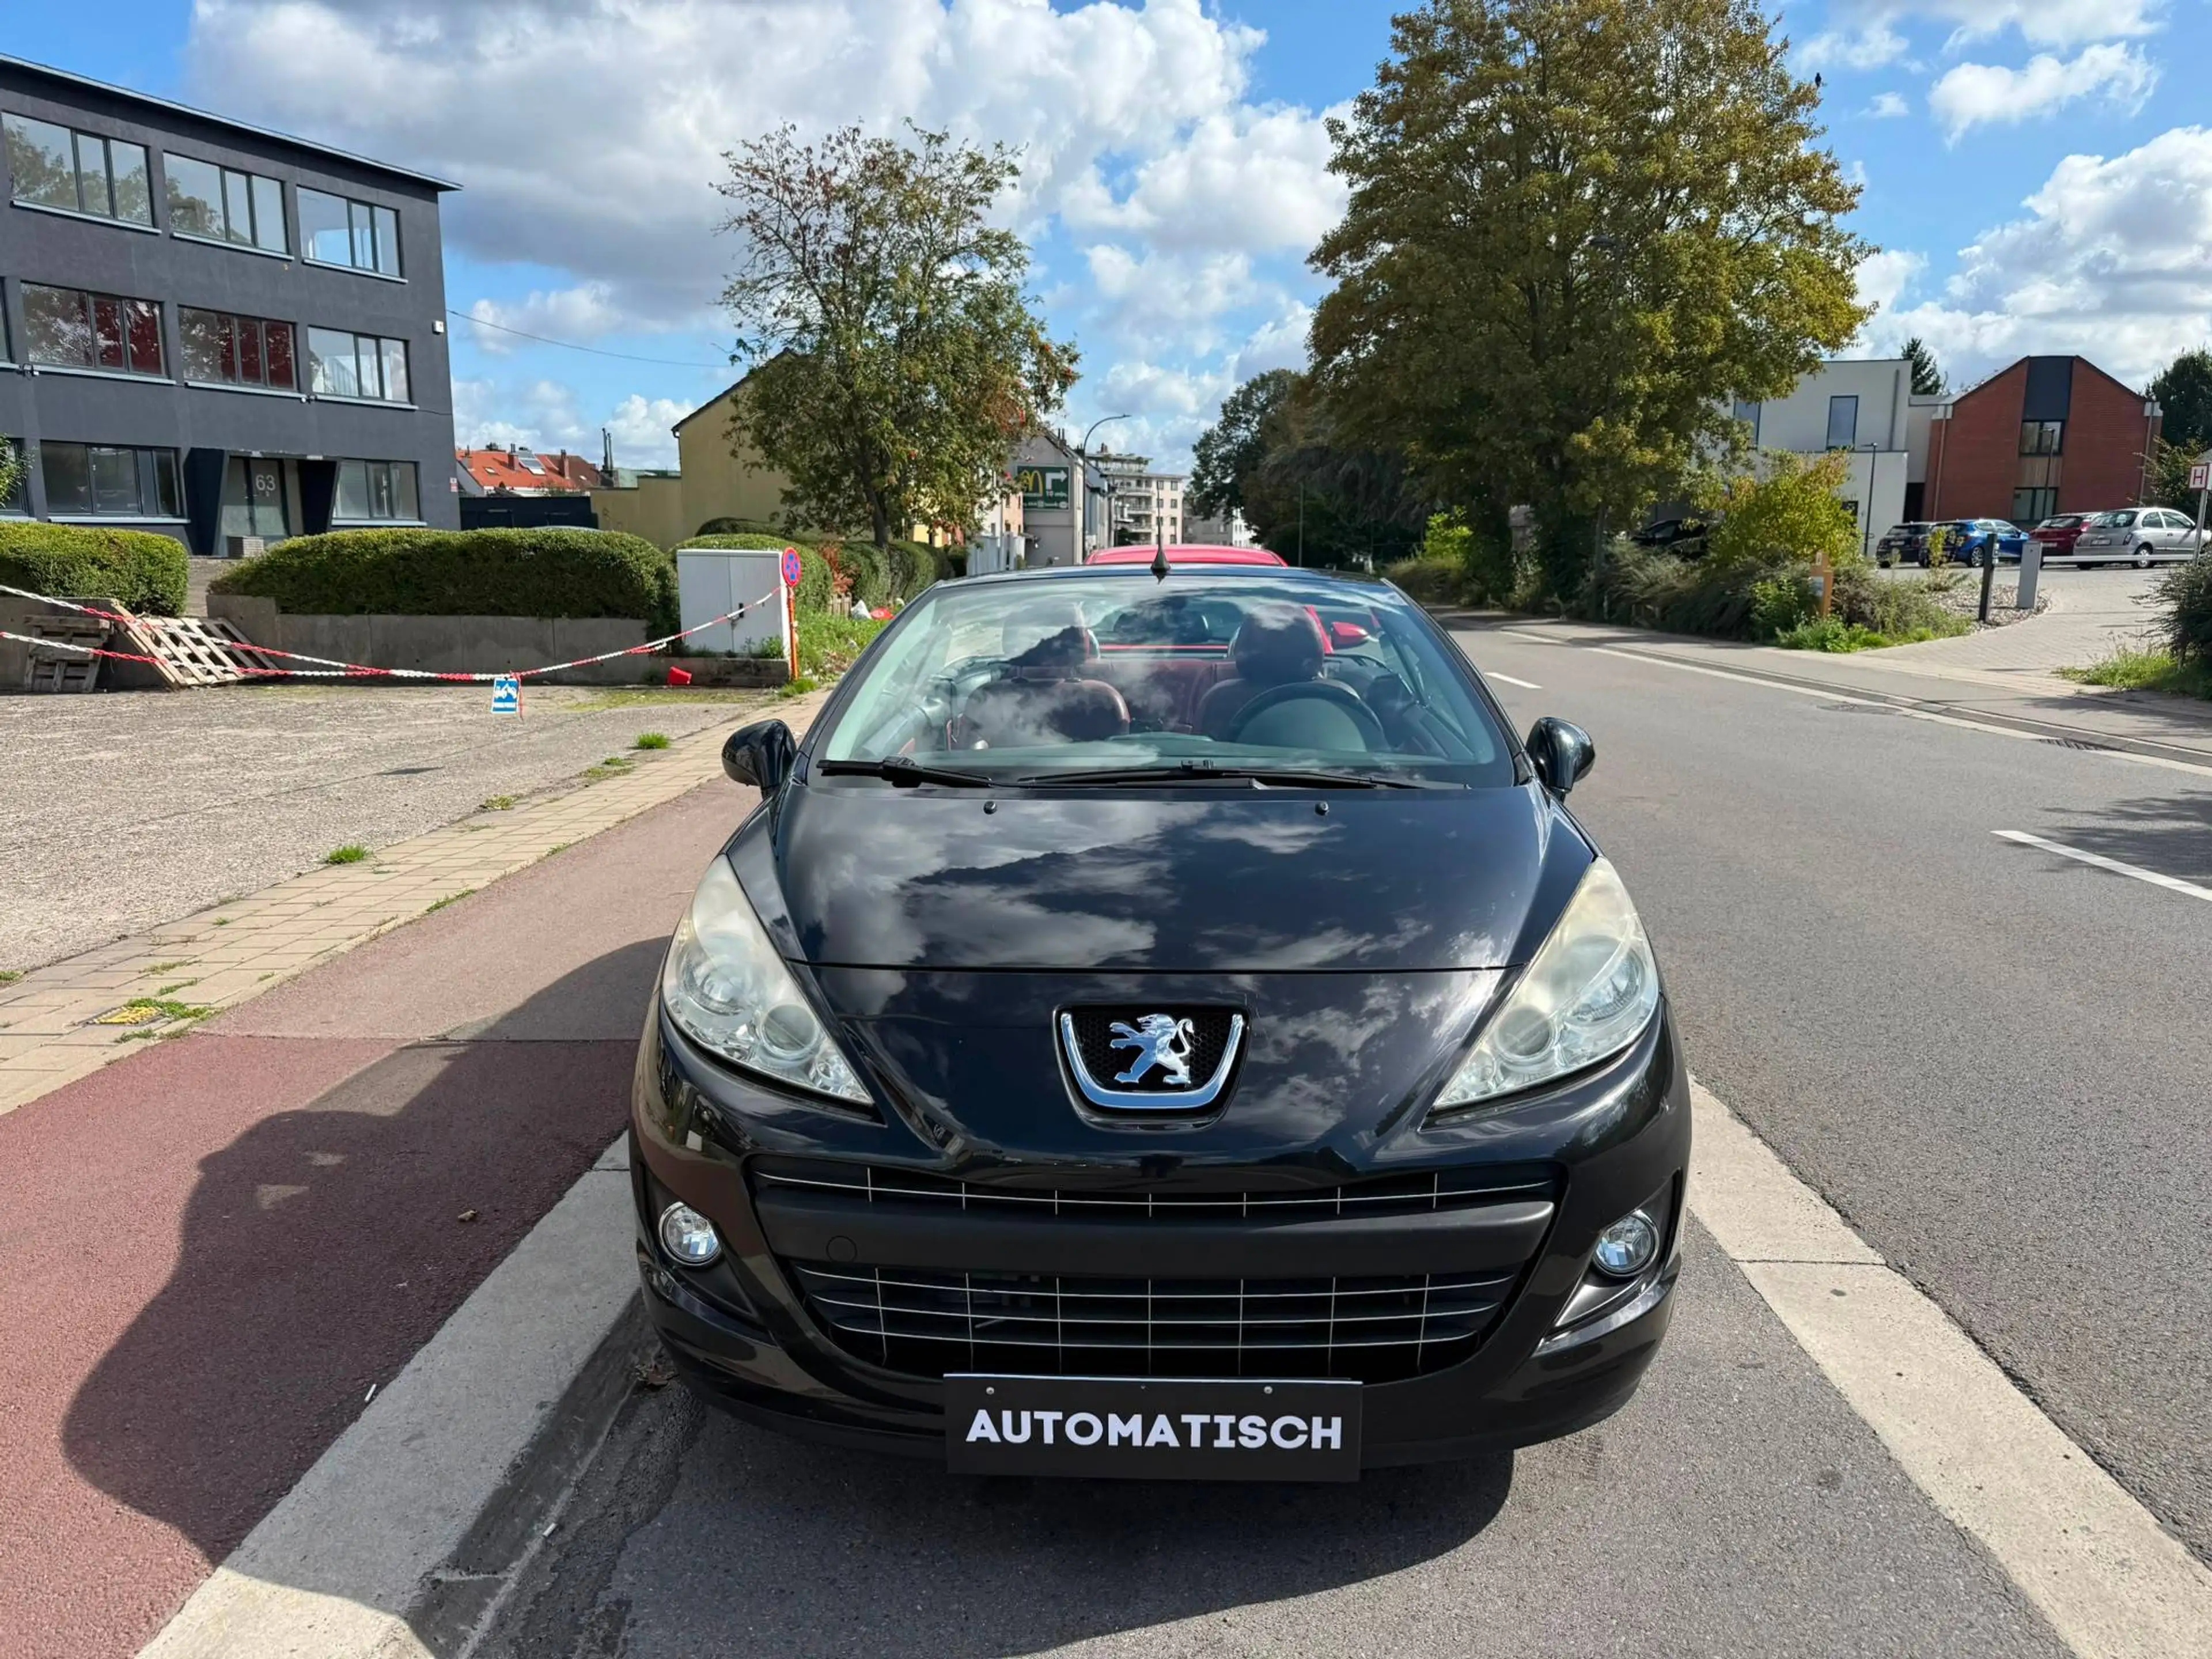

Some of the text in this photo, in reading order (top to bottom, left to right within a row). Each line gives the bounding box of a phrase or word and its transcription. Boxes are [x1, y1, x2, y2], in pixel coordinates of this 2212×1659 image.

[256, 475, 276, 491] 63
[2193, 468, 2204, 484] H
[965, 1409, 1342, 1449] AUTOMATISCH
